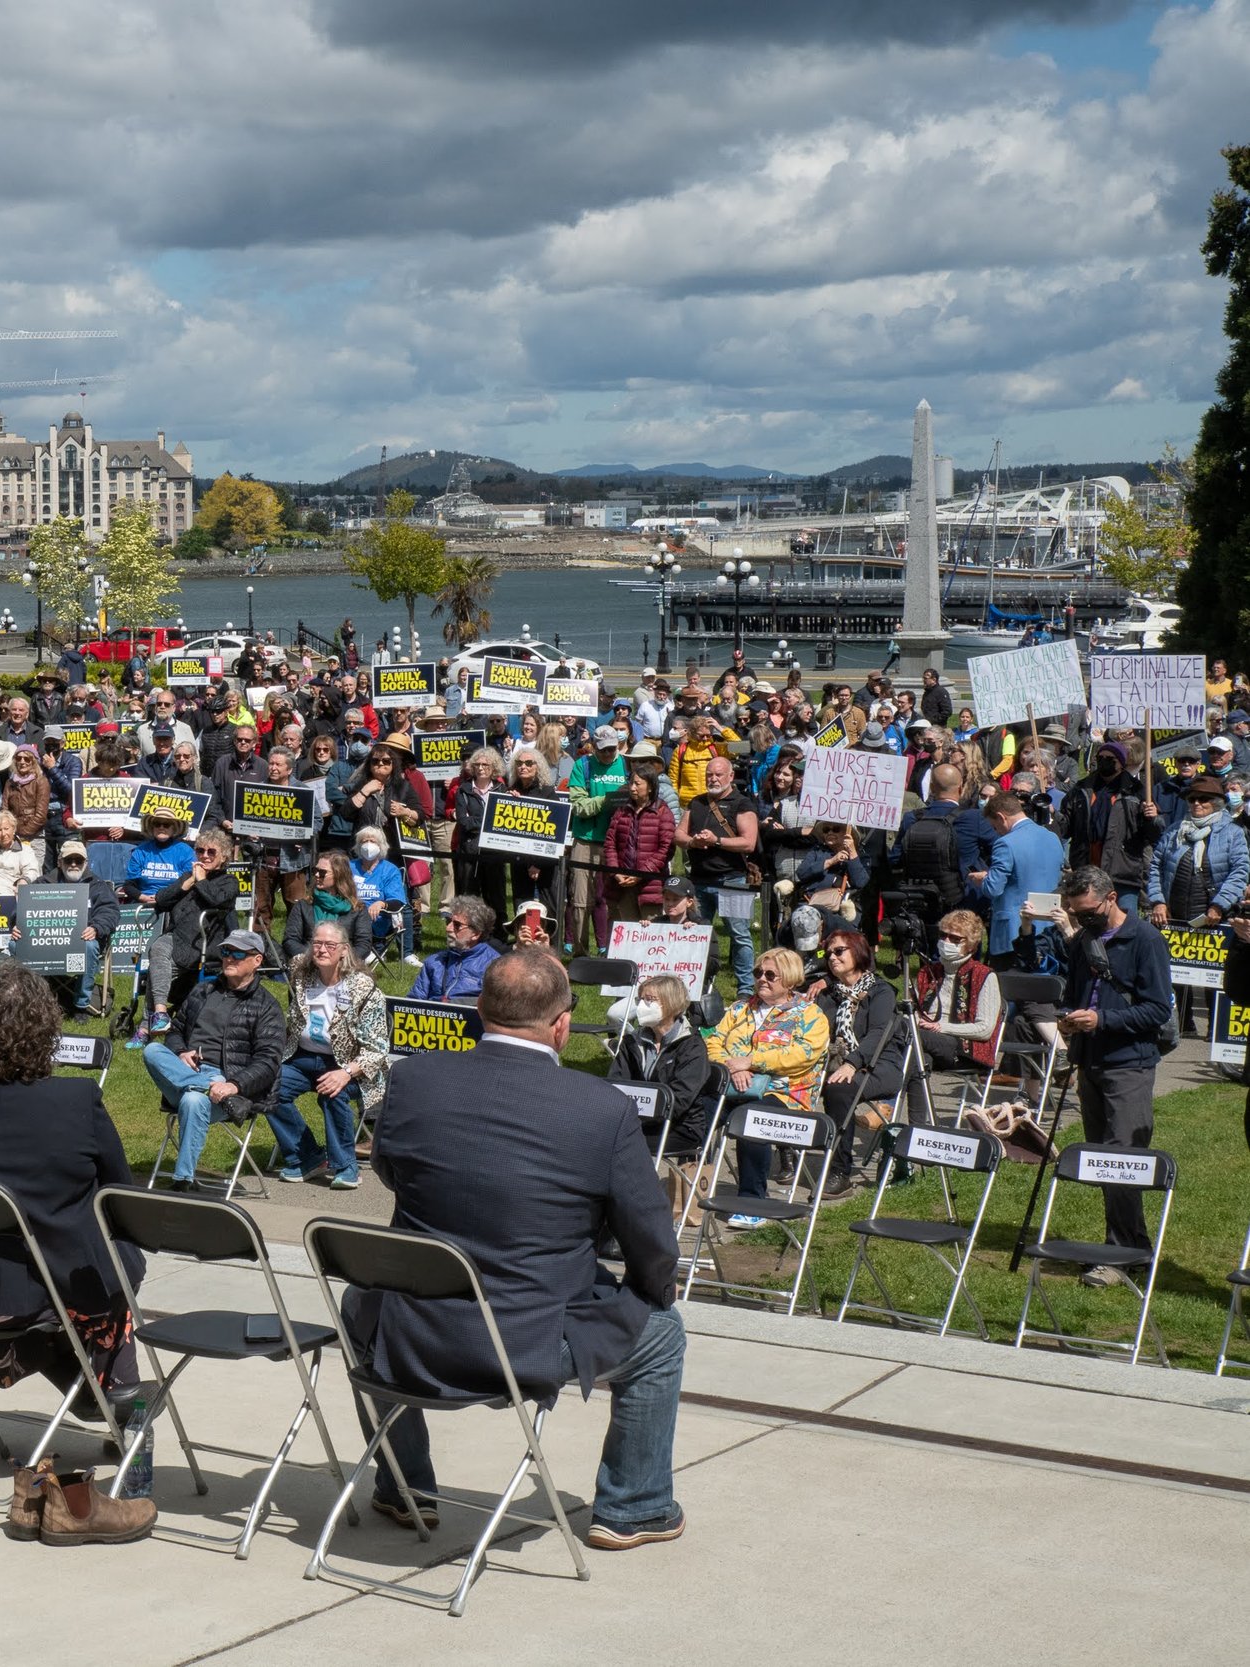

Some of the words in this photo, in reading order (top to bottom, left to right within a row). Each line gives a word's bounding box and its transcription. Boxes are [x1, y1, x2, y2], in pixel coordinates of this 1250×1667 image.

[970, 658, 982, 674] IF
[986, 653, 1008, 672] YOU
[1012, 648, 1039, 668] TOOK
[1042, 642, 1070, 662] HOME
[381, 671, 421, 682] FAMILY
[490, 664, 533, 679] FAMILY
[994, 671, 1014, 690] FOR
[1016, 669, 1024, 685] A
[1025, 660, 1070, 682] PATIENT
[381, 680, 427, 691] DOCTOR
[490, 674, 537, 688] DOCTOR
[547, 685, 585, 694] FAMILY
[974, 691, 998, 710] VISIT
[1002, 686, 1038, 705] WOULD
[1060, 676, 1084, 696] STILL
[547, 693, 590, 702] DOCTOR
[980, 710, 996, 726] BE
[999, 706, 1011, 722] IN
[64, 731, 93, 742] AMILY
[816, 724, 838, 746] FAMILY
[422, 751, 460, 762] DOCT
[807, 749, 820, 770] A
[824, 750, 879, 777] NURSE
[82, 787, 133, 798] FAMILY
[852, 778, 893, 802] NOT
[83, 797, 134, 808] DOCTO
[142, 793, 192, 810] FAMILY
[243, 792, 297, 808] FAMILY
[497, 799, 521, 807] EVERYONE
[521, 801, 545, 809] DESERVES
[800, 794, 812, 816] A
[140, 803, 194, 821] DOOR
[243, 803, 303, 820] DOCTOR
[494, 803, 552, 823] FAMILY
[493, 815, 557, 836] DOCTOR
[154, 870, 179, 879] MATTERS
[26, 910, 78, 918] EVERYONE
[27, 919, 76, 927] DESERVES
[39, 928, 74, 936] FAMILY
[631, 930, 664, 942] Billion
[669, 931, 708, 942] Museum
[1160, 930, 1226, 949] FAMILY
[648, 946, 667, 956] OR
[1170, 945, 1228, 963] OCTO
[638, 962, 671, 972] MENTAL
[674, 962, 702, 972] HEALTH
[1170, 958, 1224, 968] ALTHCAREMATTERS.C
[394, 1006, 425, 1015] EVERYONE
[426, 1010, 458, 1018] DESERVES
[394, 1012, 467, 1036] FAMILY
[394, 1029, 476, 1052] DOCTOR
[60, 1044, 90, 1052] SERVED
[627, 1094, 651, 1104] RVED
[752, 1116, 809, 1132] RESERVED
[917, 1138, 972, 1155] RESERVED
[1087, 1159, 1149, 1171] RESERVED
[1096, 1171, 1115, 1179] John
[1119, 1171, 1136, 1180] Hicks
